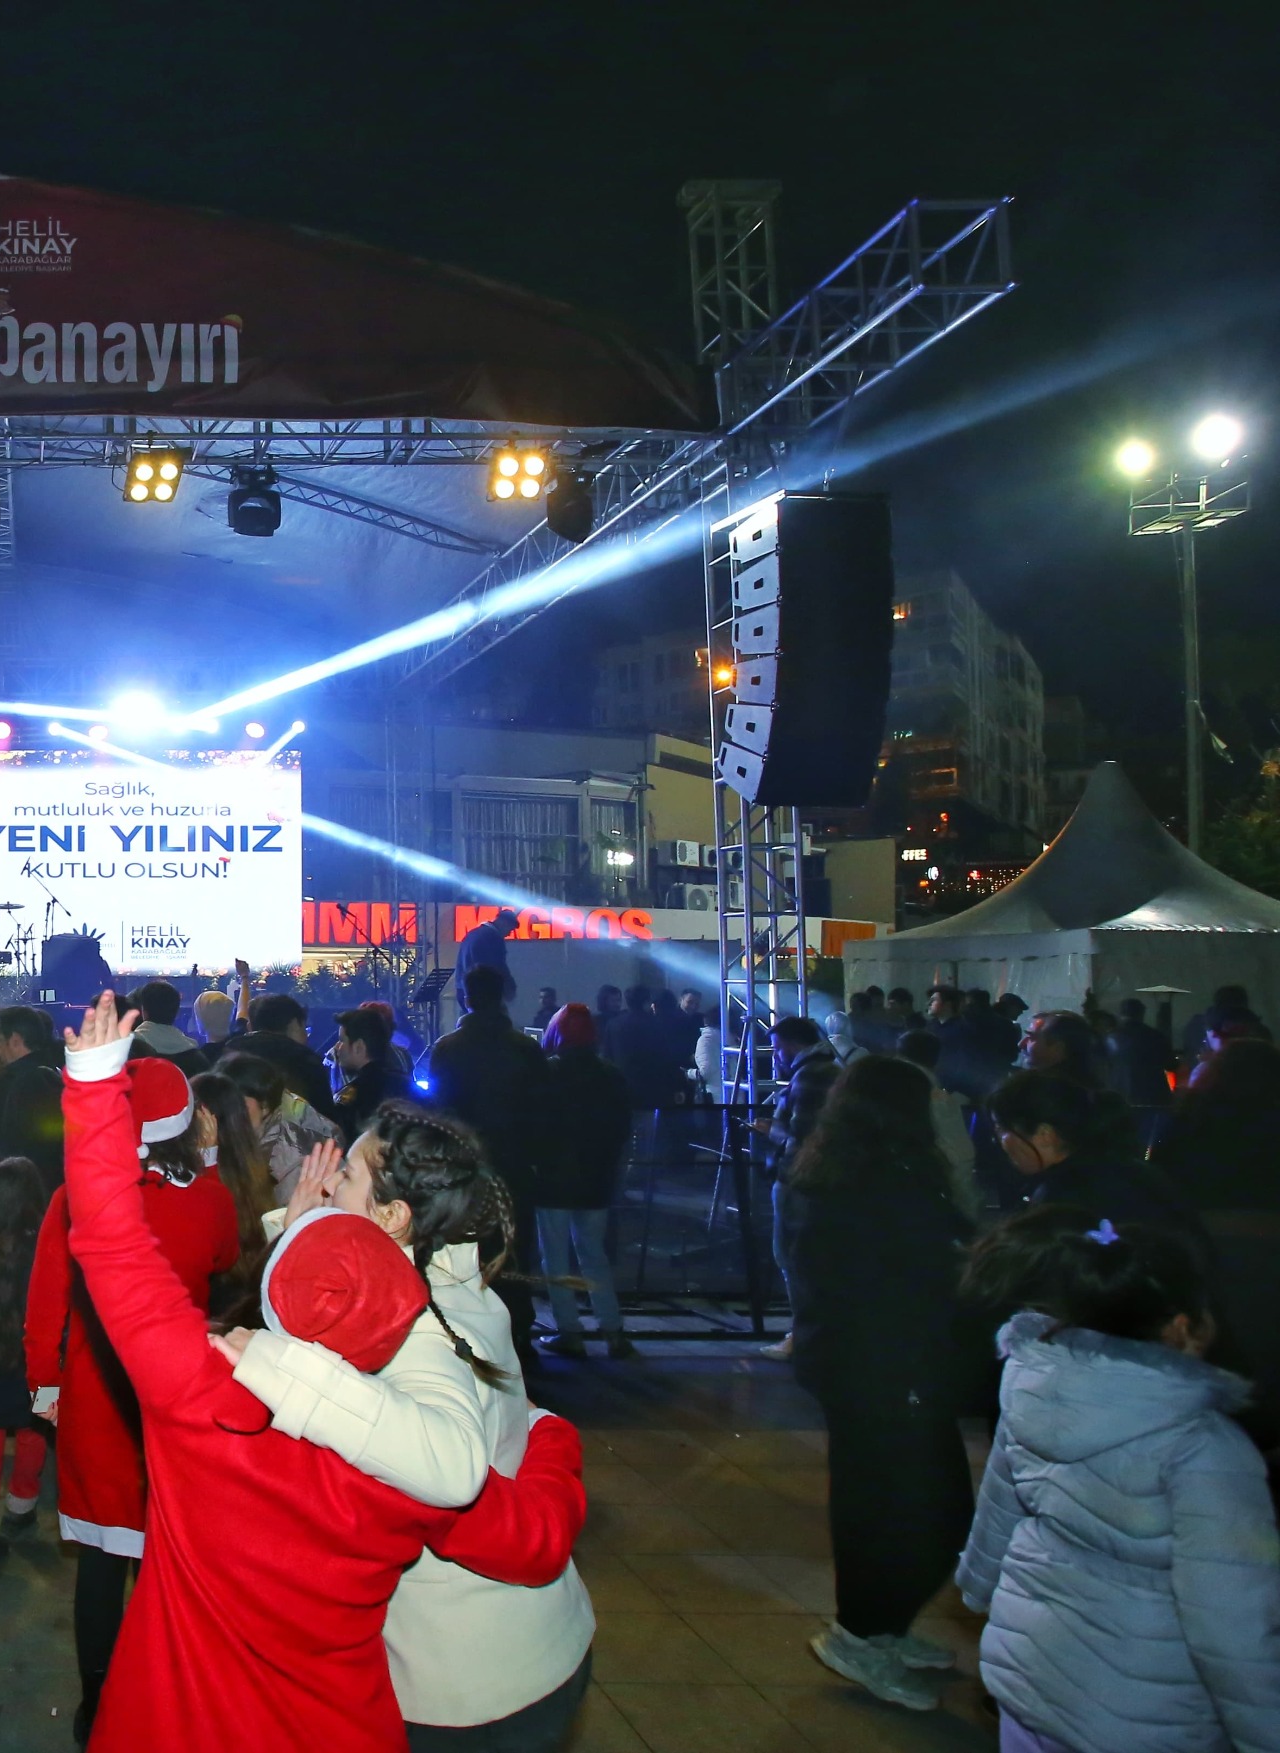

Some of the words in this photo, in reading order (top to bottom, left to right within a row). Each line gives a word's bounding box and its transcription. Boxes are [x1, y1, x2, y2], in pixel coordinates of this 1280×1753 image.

[85, 781, 155, 799] Sağlık,
[14, 803, 114, 816] mutluluk
[120, 805, 144, 816] ve
[151, 803, 231, 816] huzurla
[110, 825, 283, 852] YILINIZ
[27, 862, 115, 878] KUTLU
[124, 861, 228, 878] OLSUN!
[131, 924, 186, 936] HELİL
[455, 905, 654, 942] MGROS
[131, 938, 191, 948] KINAY
